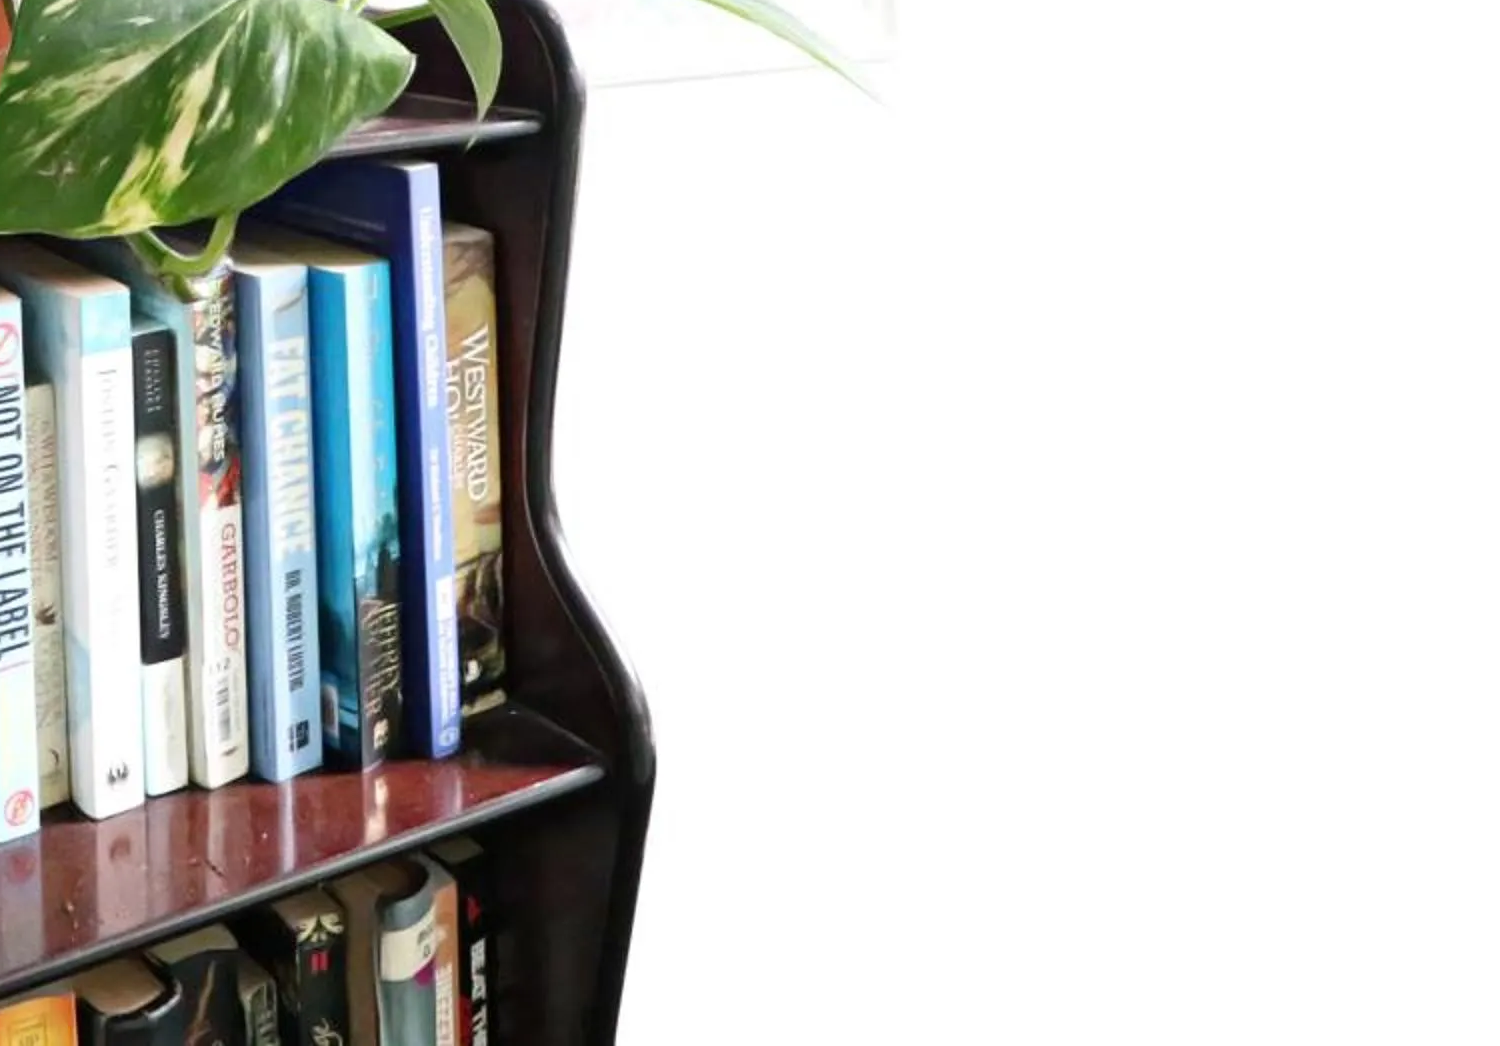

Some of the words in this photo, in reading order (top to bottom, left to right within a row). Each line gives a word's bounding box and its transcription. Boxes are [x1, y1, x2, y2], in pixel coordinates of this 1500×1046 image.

[266, 336, 307, 400] FAT
[460, 323, 489, 503] WESTWARD
[269, 409, 314, 561] CHANCE
[153, 509, 167, 571] CHARLES
[220, 523, 241, 653] GARBOLO
[155, 573, 171, 640] KINGSLEY
